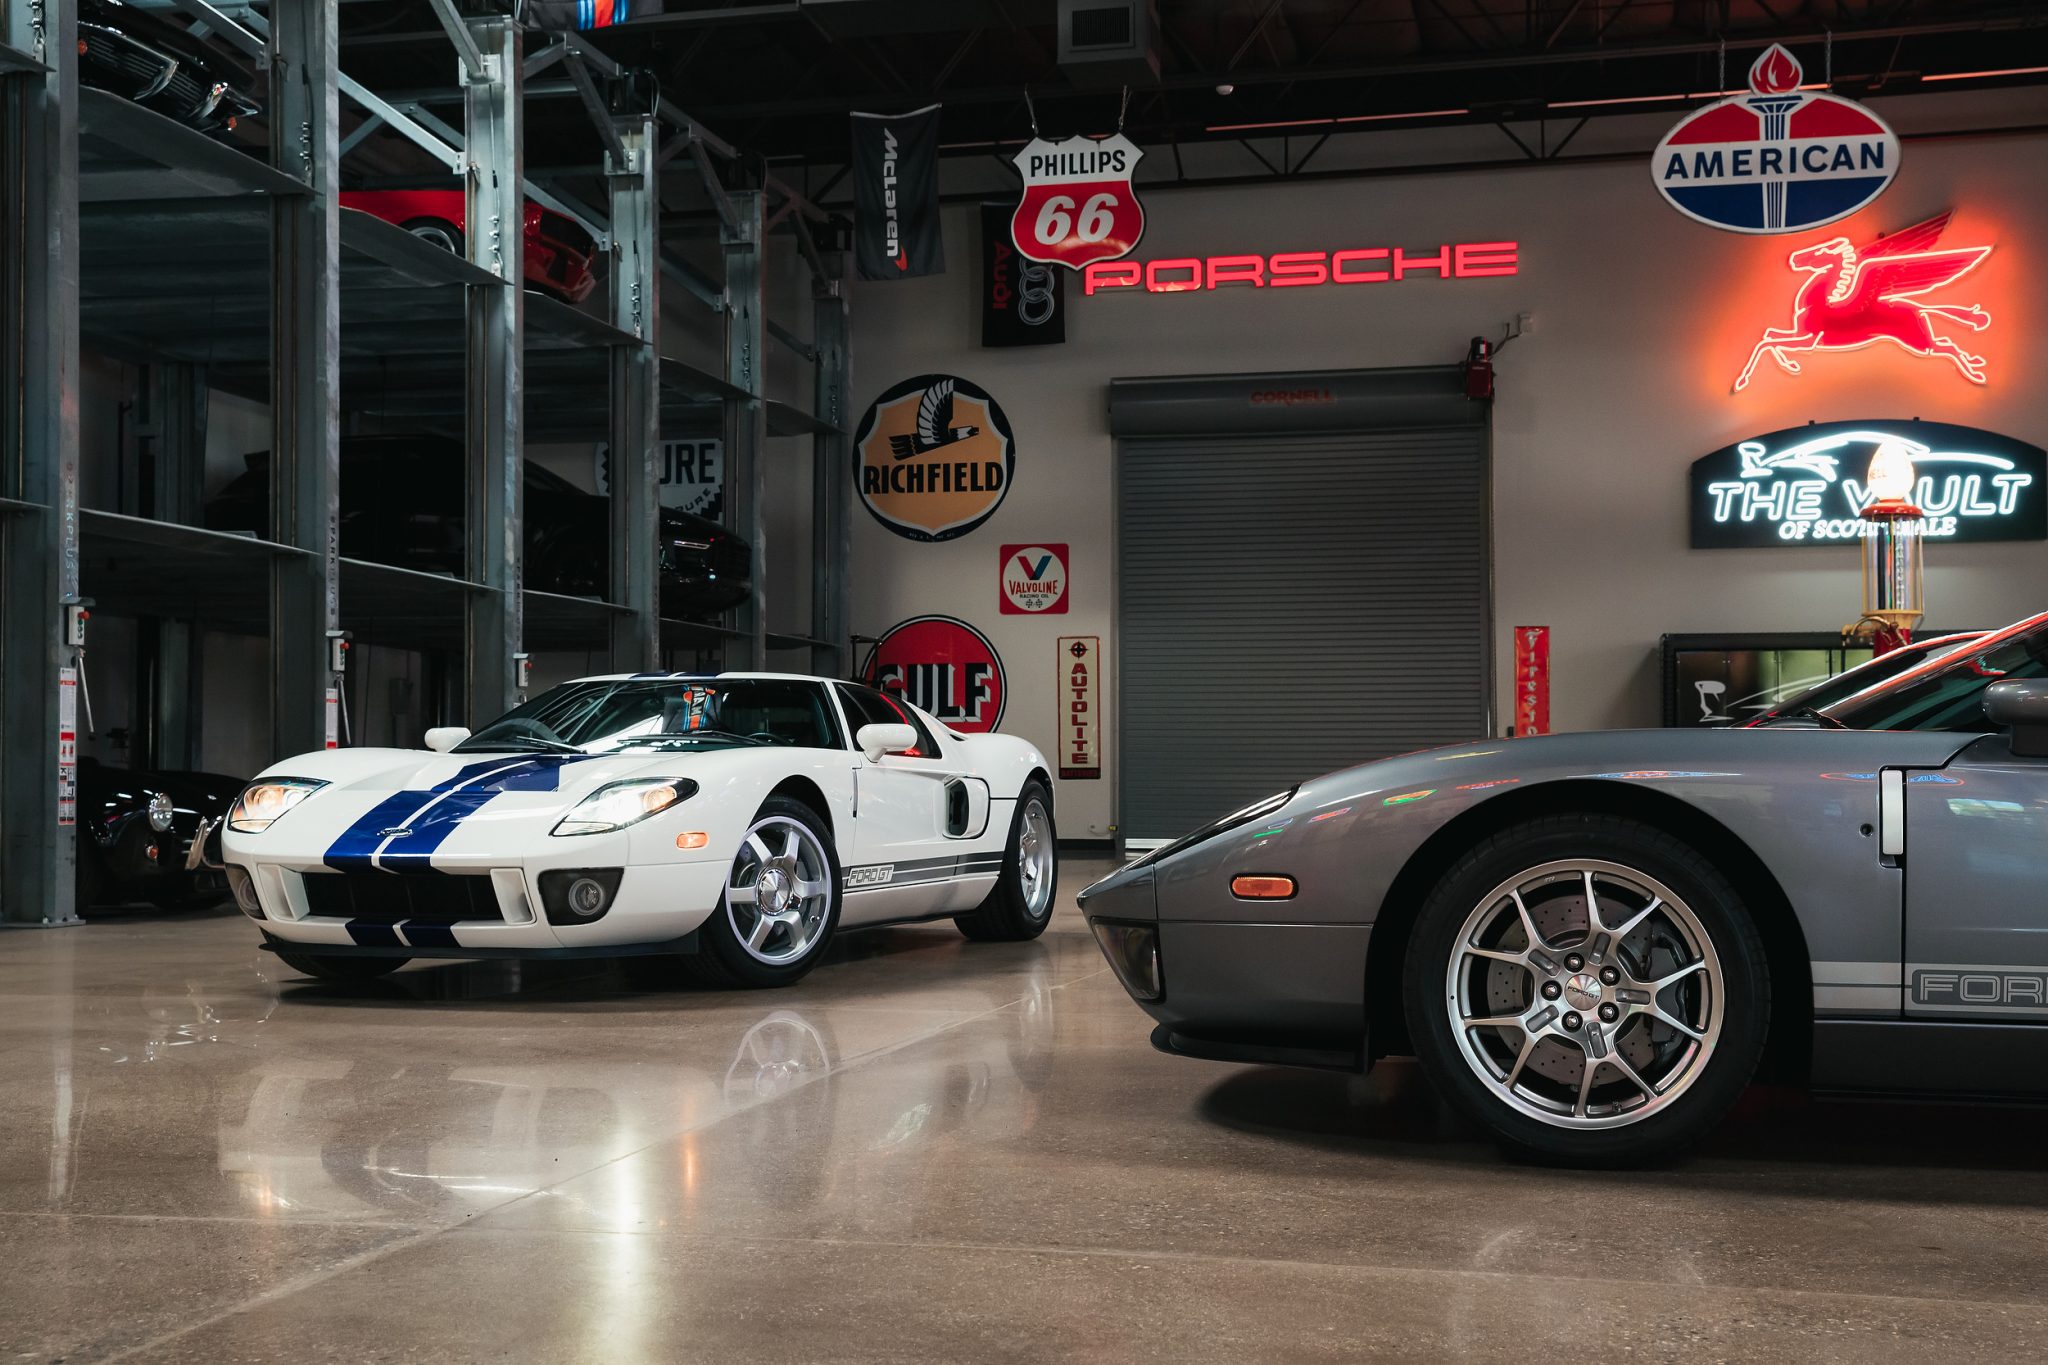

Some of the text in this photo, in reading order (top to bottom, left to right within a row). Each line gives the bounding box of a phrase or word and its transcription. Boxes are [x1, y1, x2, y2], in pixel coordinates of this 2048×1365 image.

[1029, 149, 1127, 179] PHILLIPS
[1664, 141, 1885, 181] AMERICAN
[883, 128, 899, 257] McLaren
[1034, 192, 1119, 246] 66
[992, 240, 1012, 310] Audi
[1084, 241, 1518, 296] PORSCHE
[659, 443, 715, 484] URE
[863, 461, 1004, 496] RICHFIELD
[1708, 479, 1827, 523] THE
[1778, 520, 1809, 539] OF
[1008, 579, 1059, 596] VALVOLINE
[879, 663, 993, 723] GULF
[1525, 628, 1544, 736] Firesto
[1070, 662, 1089, 765] AUTOLITE
[850, 867, 893, 883] FORD GT
[1567, 986, 1600, 999] FORD GT
[1919, 973, 2048, 1004] FOR
